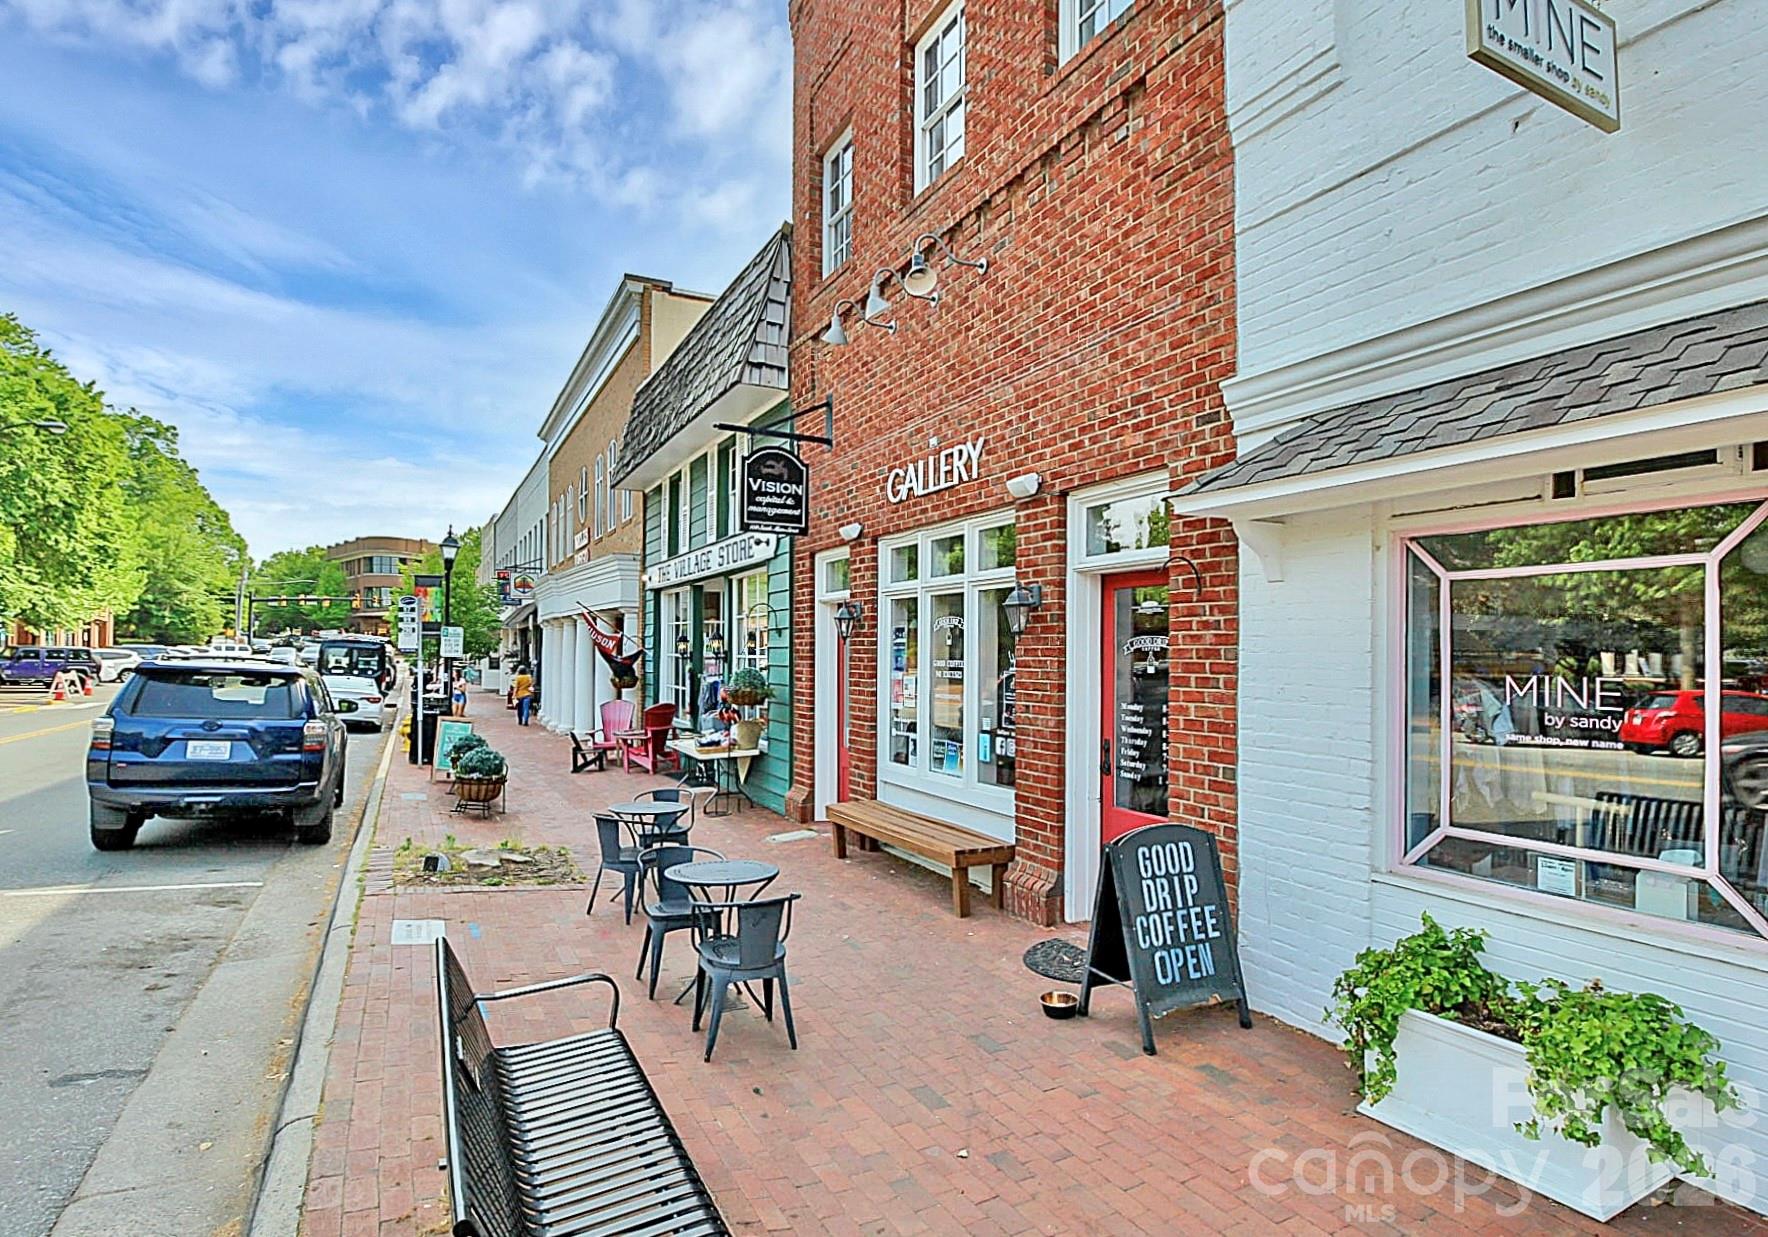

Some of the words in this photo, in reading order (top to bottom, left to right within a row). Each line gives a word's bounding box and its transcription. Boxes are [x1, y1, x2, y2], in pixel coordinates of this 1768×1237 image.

[1487, 24, 1506, 46] the
[1508, 39, 1545, 67] smaller
[1546, 60, 1571, 83] shop
[1571, 77, 1584, 94] by
[886, 436, 985, 503] GALLERY
[748, 477, 803, 496] VISION
[747, 505, 801, 516] management
[657, 564, 672, 583] THE
[674, 550, 713, 578] VILLAGE
[717, 535, 755, 567] STORE
[1505, 674, 1624, 712] MINE
[1120, 702, 1144, 712] Monday
[1120, 713, 1144, 724] Tuesday
[1544, 712, 1566, 729] by
[1570, 715, 1623, 733] sandy
[1120, 725, 1152, 737] Wednesday
[1120, 736, 1147, 748] Thursday
[1505, 734, 1533, 743] same
[1565, 737, 1590, 747] new
[1591, 739, 1625, 750] name
[1120, 747, 1140, 759] Friday
[1120, 758, 1146, 771] Saturday
[1120, 769, 1141, 782] Sunday
[1136, 840, 1196, 879] GOOD
[1141, 874, 1199, 913] DRIP
[1135, 904, 1222, 950] COFFEE
[1153, 941, 1216, 986] OPEN
